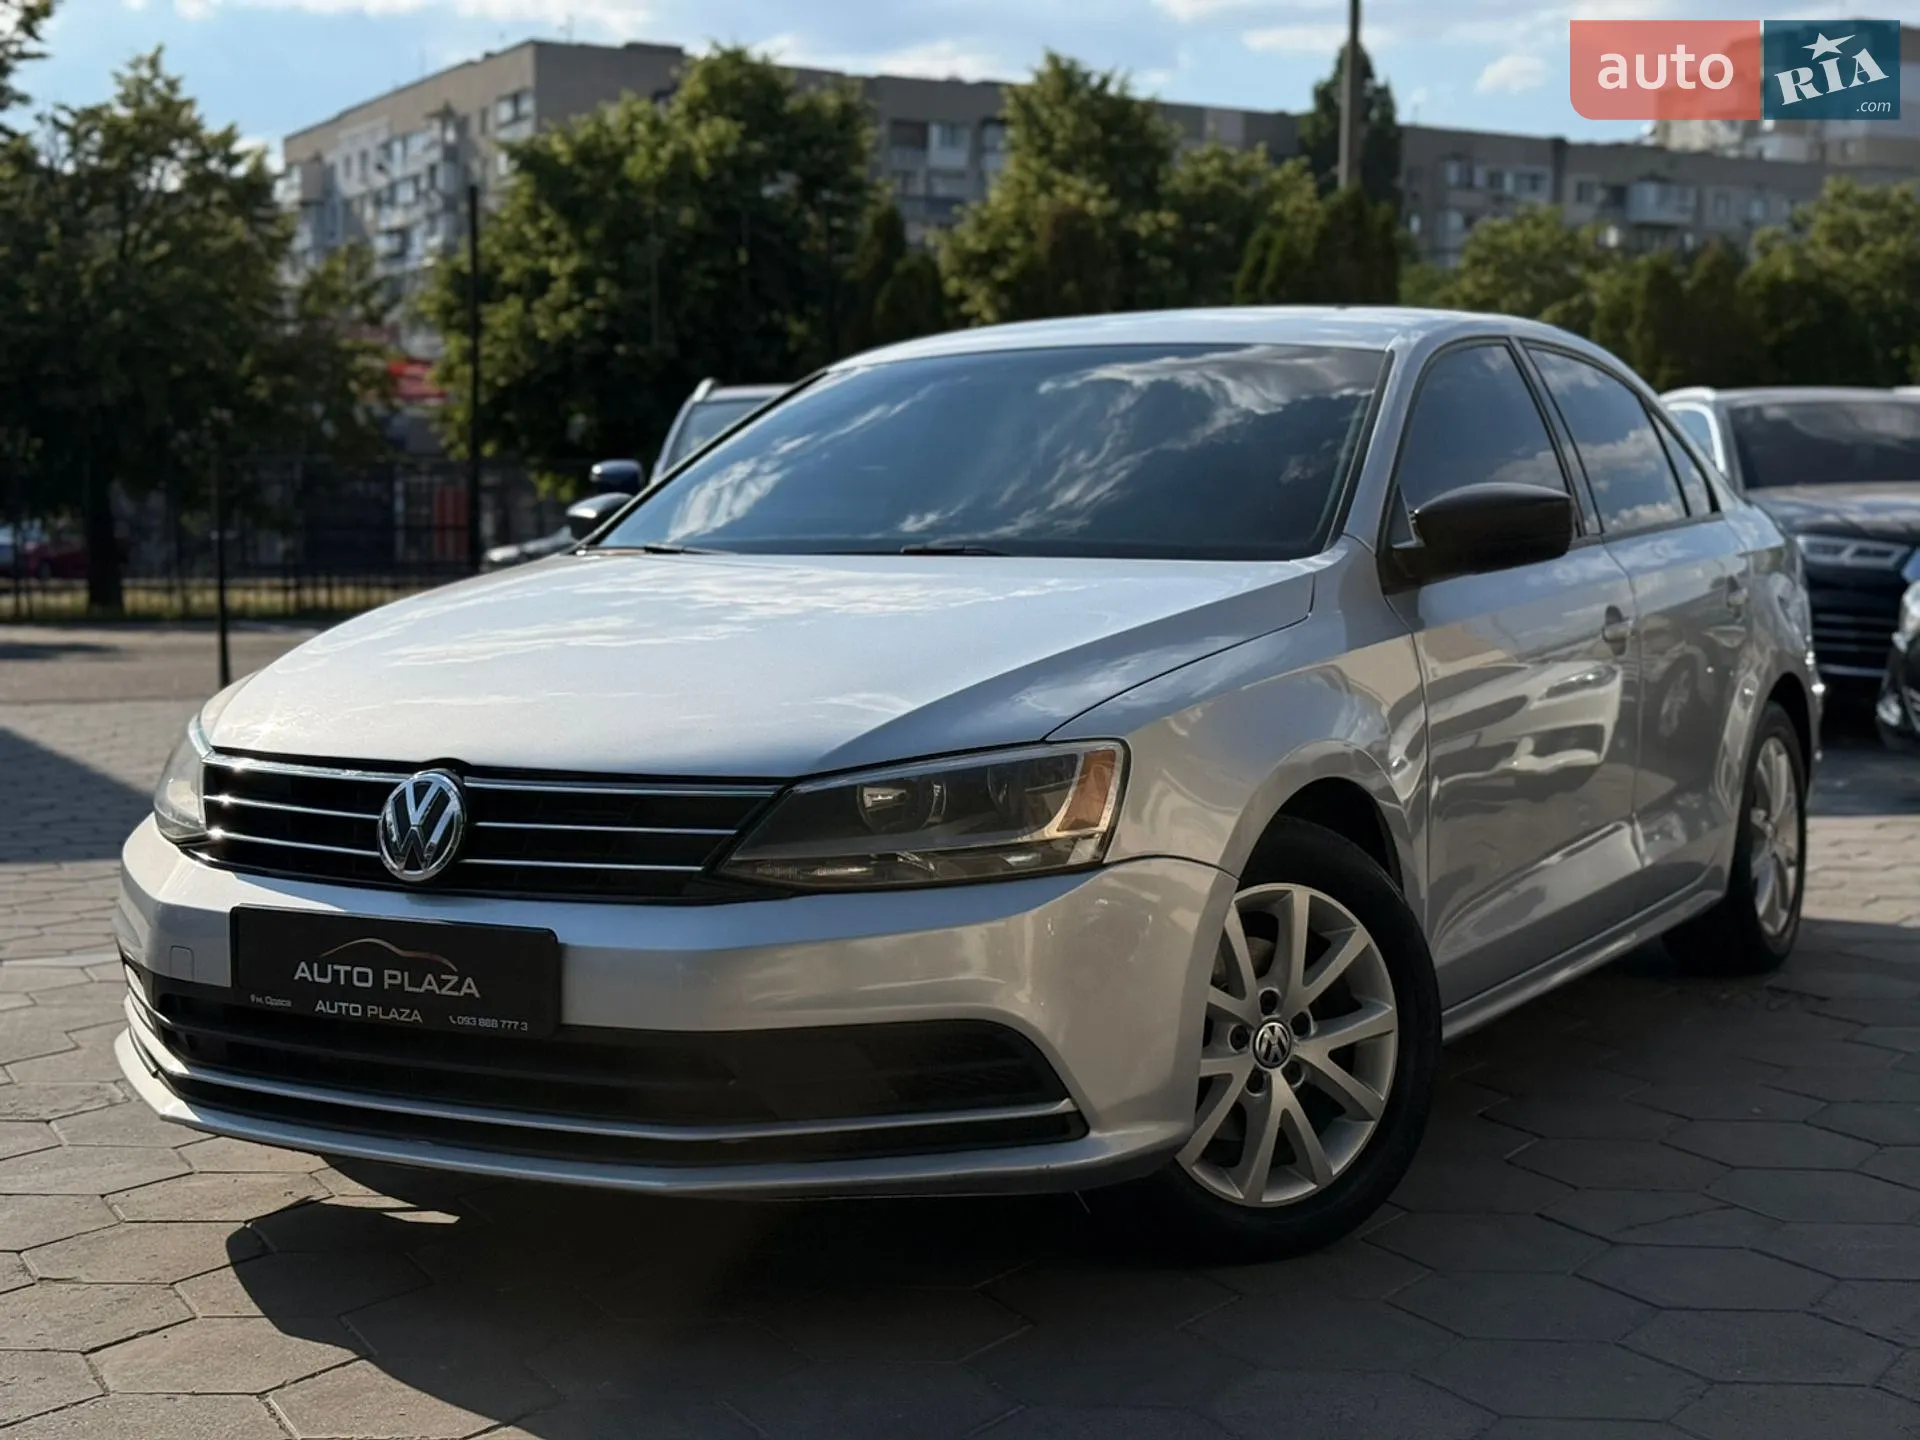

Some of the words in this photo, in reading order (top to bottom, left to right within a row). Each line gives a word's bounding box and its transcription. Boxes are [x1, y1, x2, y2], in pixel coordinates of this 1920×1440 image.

[293, 960, 373, 988] AUTO
[383, 969, 480, 998] PLAZA
[314, 999, 362, 1017] AUTO
[367, 1005, 423, 1023] PLAZA
[500, 1019, 519, 1030] 777
